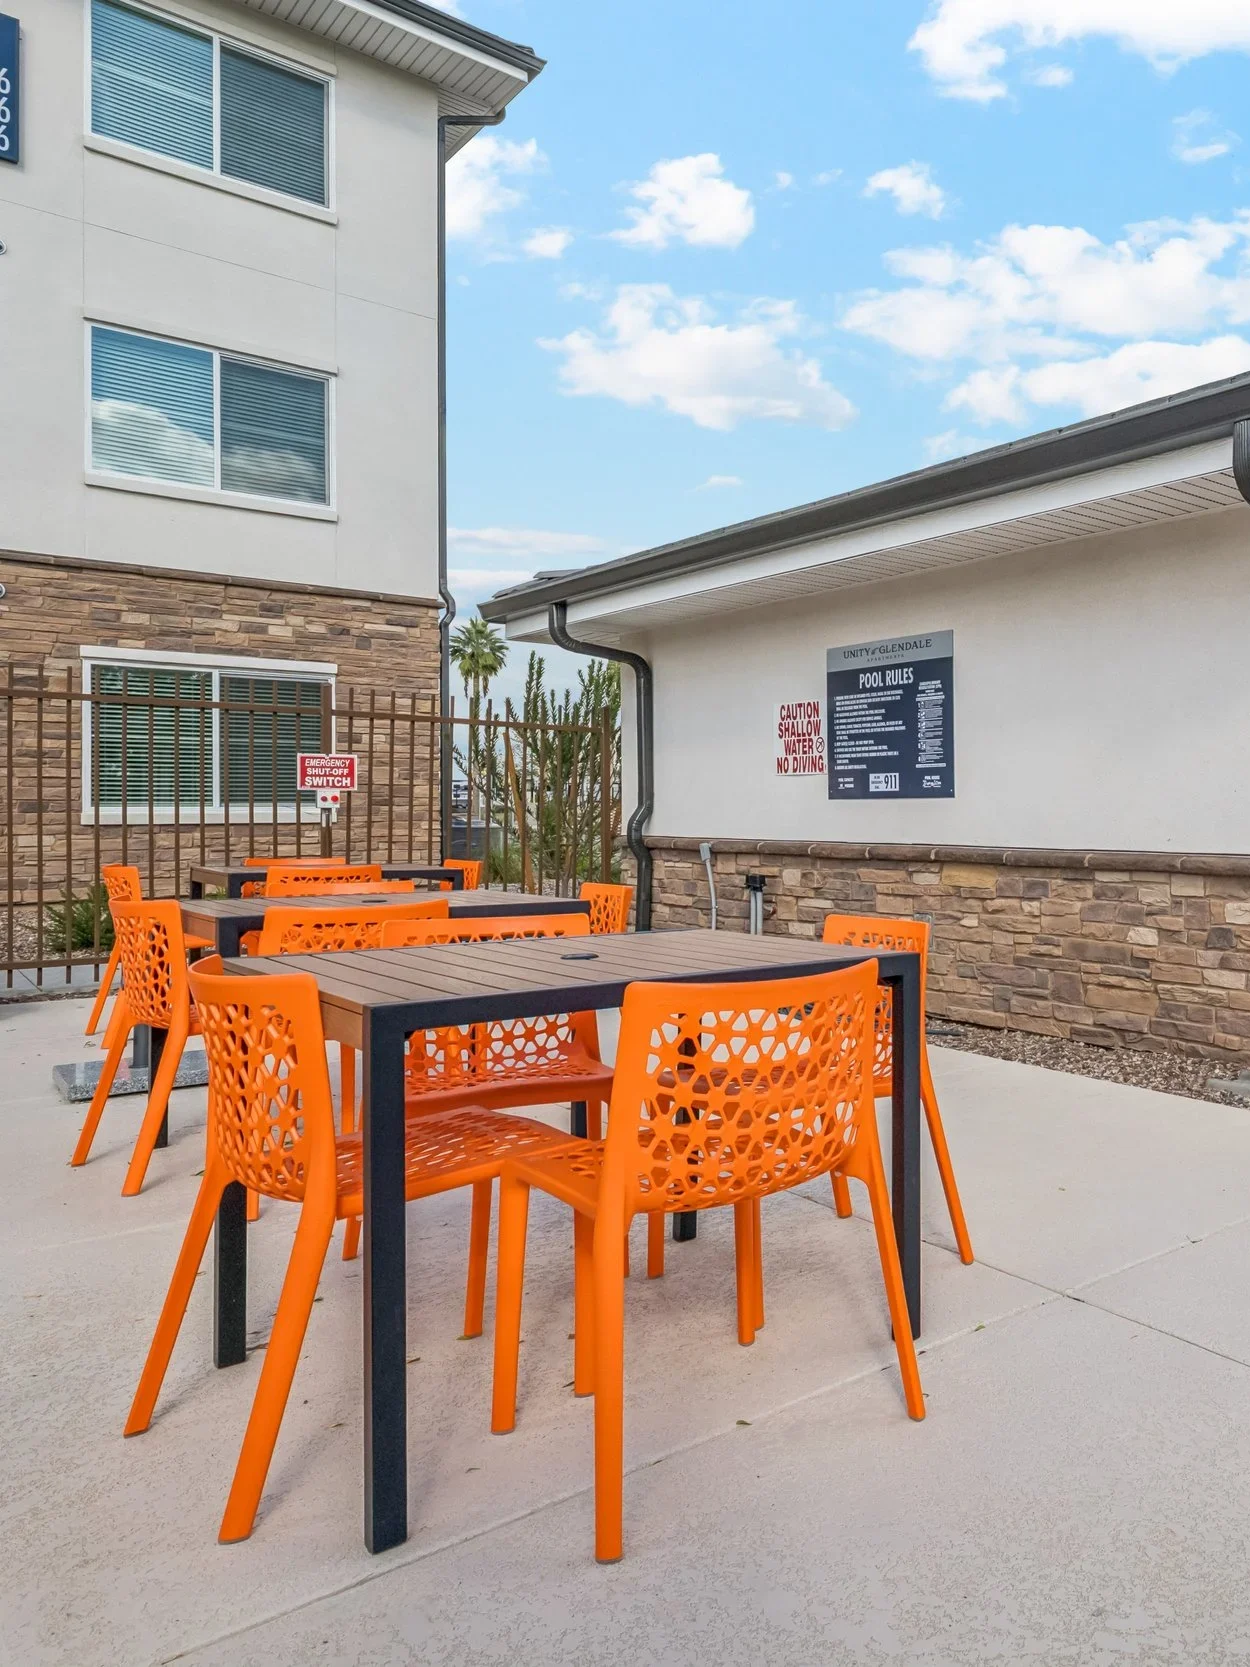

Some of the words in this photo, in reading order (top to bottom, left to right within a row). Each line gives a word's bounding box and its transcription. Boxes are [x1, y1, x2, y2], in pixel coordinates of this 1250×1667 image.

[843, 647, 871, 659] UNITY
[879, 639, 932, 654] GLENDALE
[859, 671, 883, 689] POOL
[886, 667, 914, 686] RULES
[780, 701, 819, 721] CAUTION
[778, 719, 821, 739] SHALLOW
[784, 738, 814, 756] WATER
[305, 758, 350, 768] EMERGENCY
[306, 767, 349, 775] SHUT-OFF
[776, 756, 789, 774] NO
[792, 755, 824, 773] DIVING
[304, 776, 351, 786] SWITCH
[883, 774, 897, 789] 911
